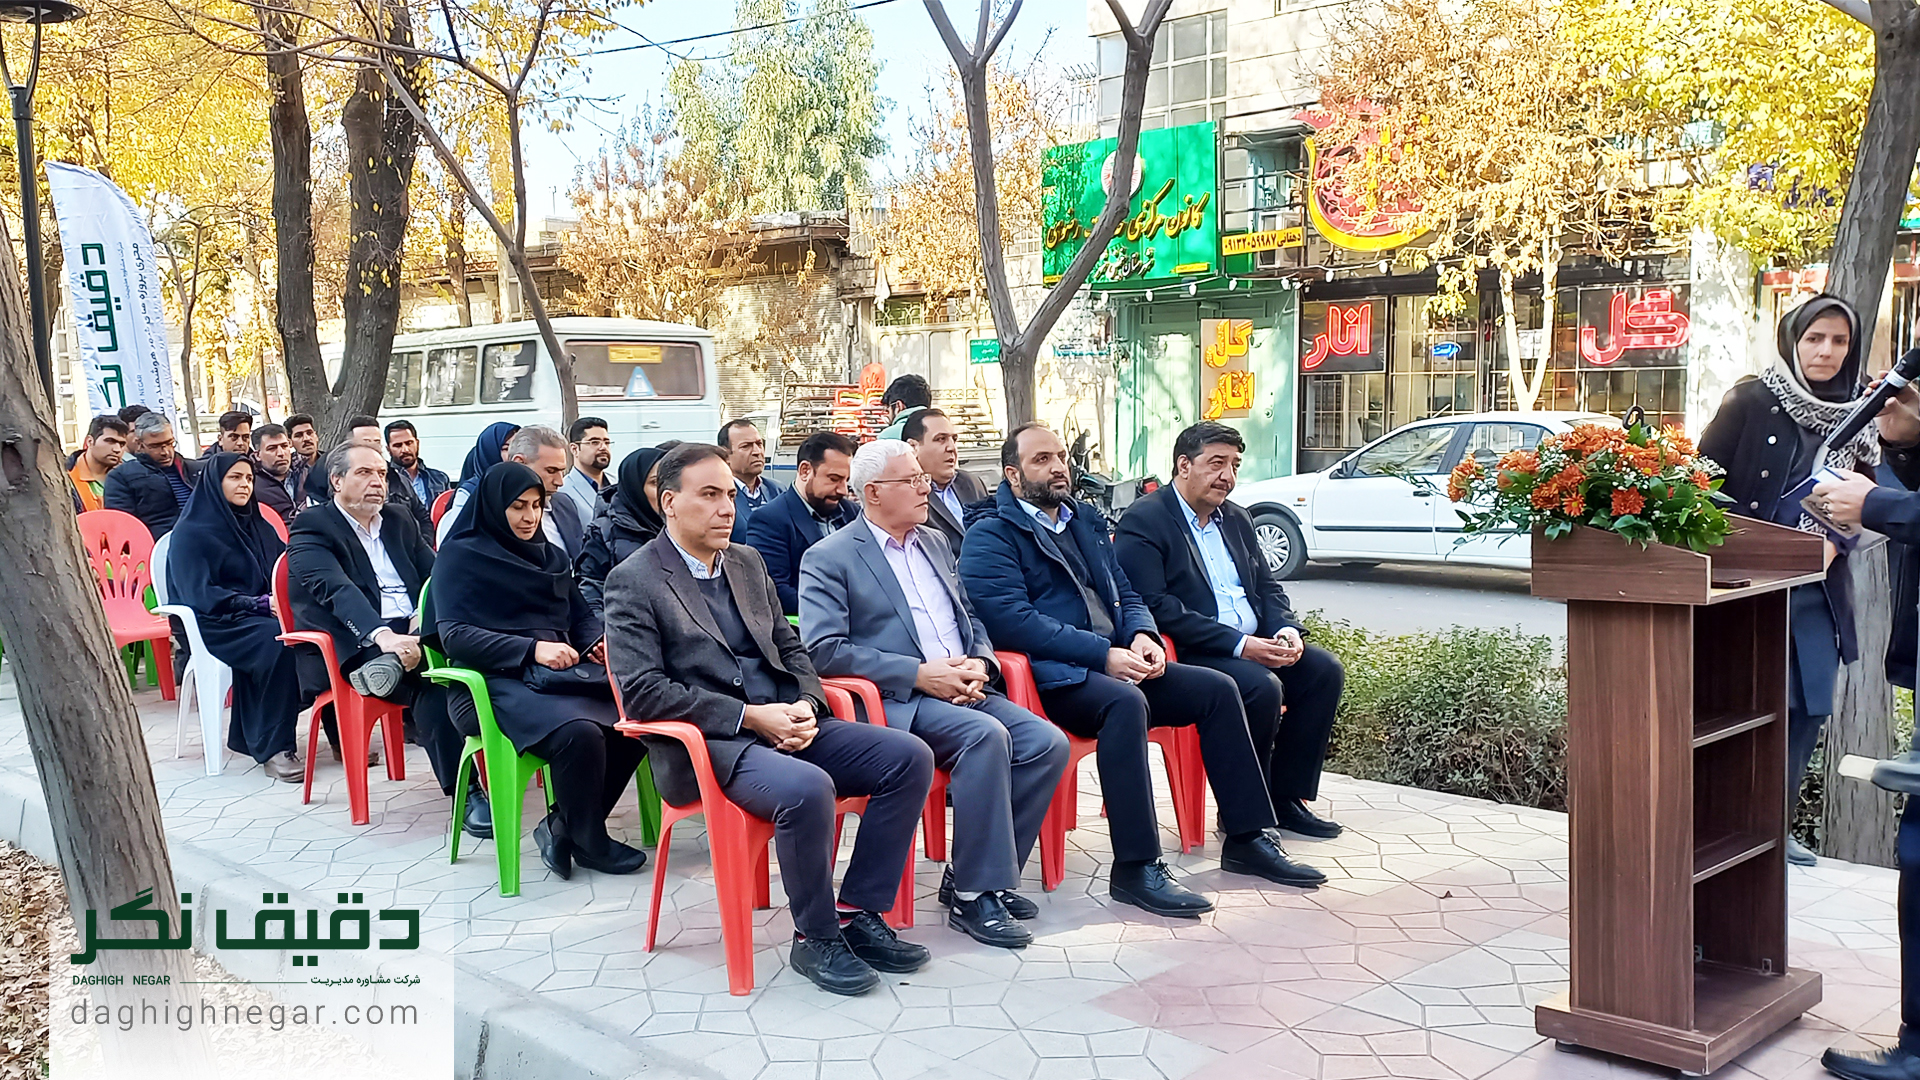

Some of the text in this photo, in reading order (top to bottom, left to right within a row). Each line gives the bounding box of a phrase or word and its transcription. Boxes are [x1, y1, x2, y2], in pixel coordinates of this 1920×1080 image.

[1127, 178, 1175, 242] مرکزی
[1165, 191, 1210, 239] کانون
[132, 242, 145, 271] مجری
[137, 273, 148, 300] پروژه
[80, 243, 127, 408] دقیق نگ
[1205, 319, 1253, 368] گل
[1303, 302, 1373, 369] انار
[1580, 289, 1691, 365] گل
[136, 374, 145, 396] NEGAR
[150, 351, 162, 396] هوشمند
[1203, 370, 1255, 420] انار
